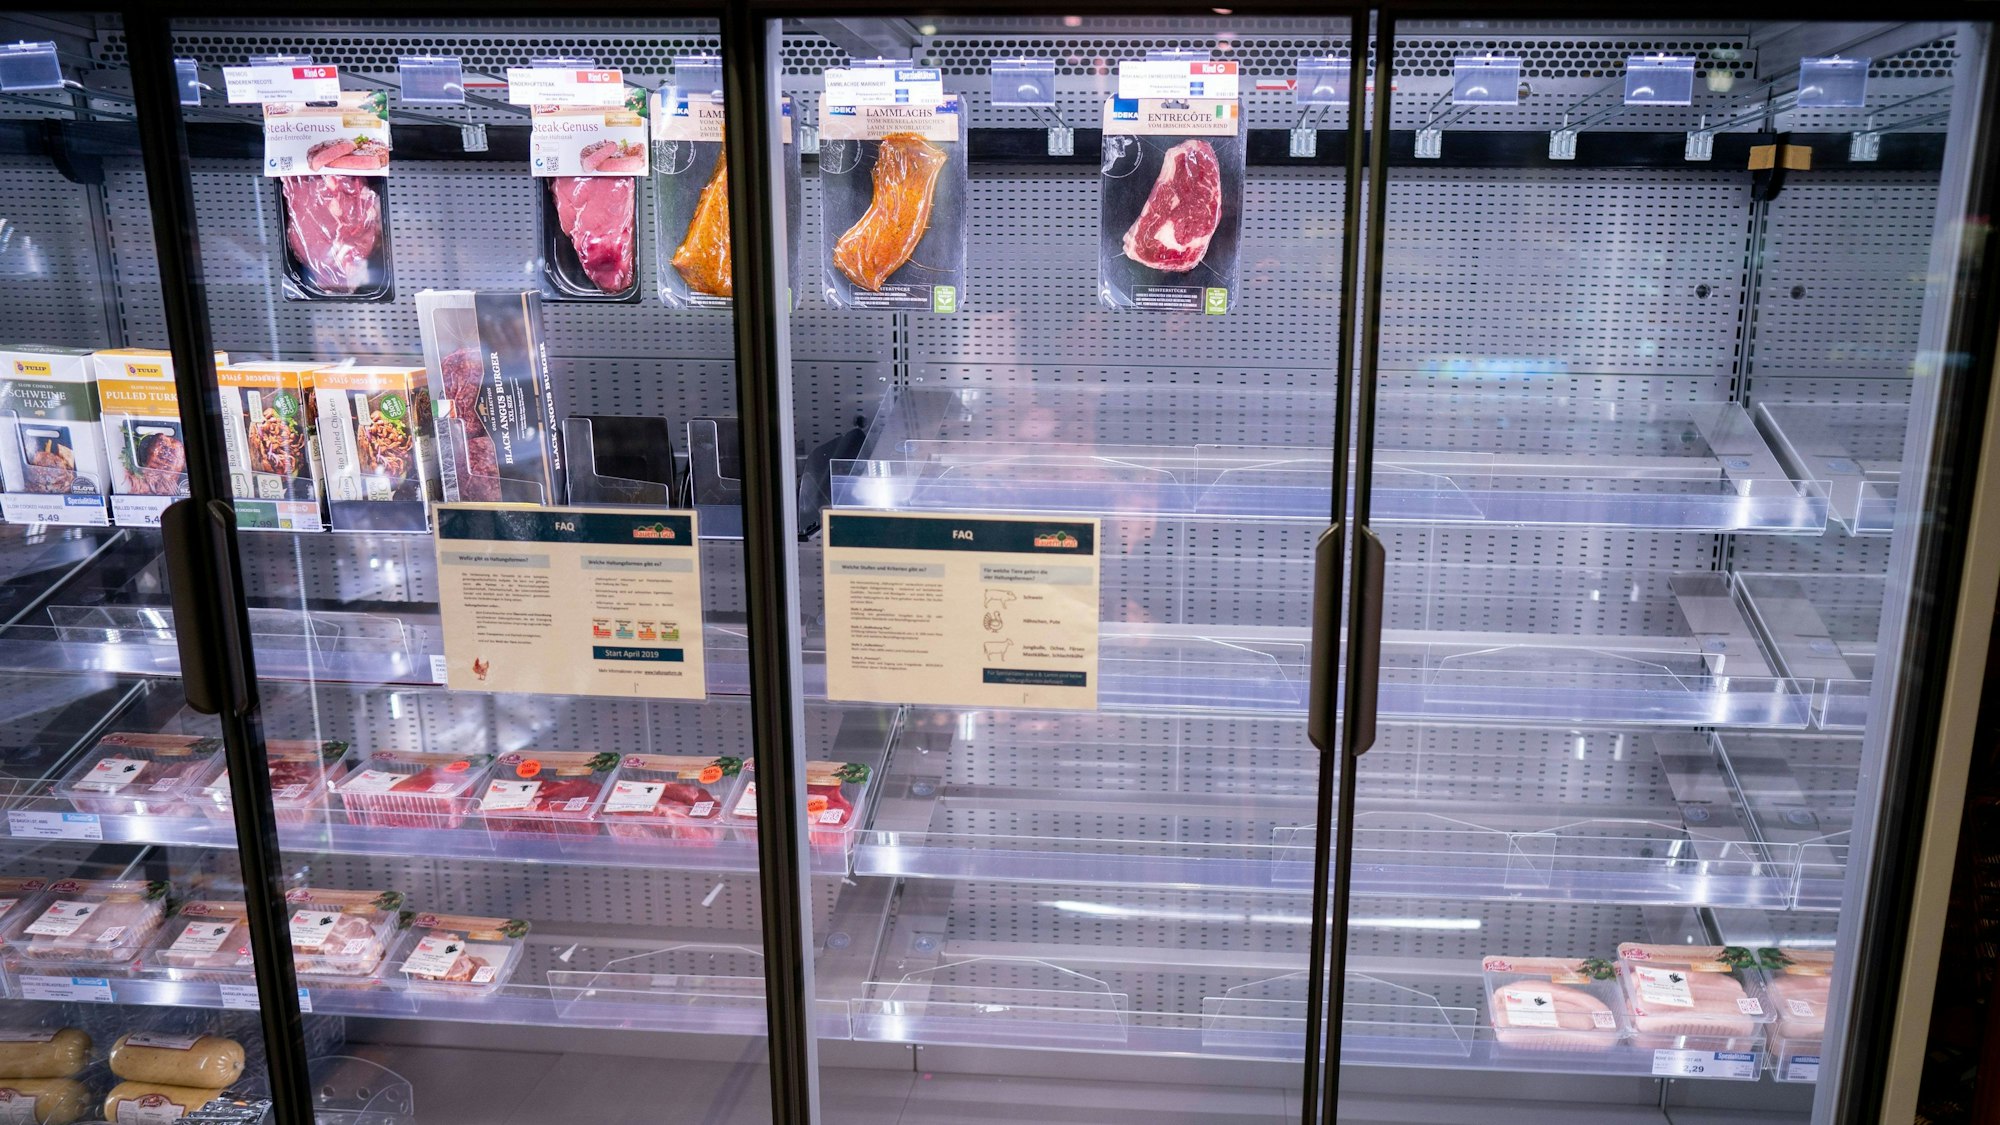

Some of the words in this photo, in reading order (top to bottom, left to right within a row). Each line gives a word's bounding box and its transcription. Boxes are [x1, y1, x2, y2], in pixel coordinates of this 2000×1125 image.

[303, 68, 317, 78] Rind
[866, 108, 932, 118] LAMMLACHS
[1148, 111, 1212, 122] ENTRECÔTE
[534, 121, 599, 133] Steak-Genuss
[539, 341, 551, 391] BURGER
[490, 351, 504, 394] BURGER
[8, 389, 67, 400] SCHWEINE
[106, 391, 147, 401] PULLED
[23, 399, 55, 409] HAXE
[487, 387, 495, 416] SELECTION
[221, 395, 230, 425] Chicken
[330, 398, 338, 428] Chicken
[497, 395, 509, 431] ANGUS
[546, 392, 557, 431] ANGUS
[226, 426, 234, 452] Pulled
[502, 431, 514, 465] BLACK
[551, 432, 561, 471] BLACK
[229, 454, 237, 467] Bio
[555, 521, 575, 533] FAQ
[633, 529, 658, 539] Bauern
[661, 531, 676, 540] Gut
[953, 530, 973, 541] FAQ
[1034, 537, 1059, 547] Bauern
[1062, 538, 1078, 548] Gut
[605, 649, 623, 658] Start
[624, 650, 641, 659] April
[641, 650, 660, 659] 2019
[1683, 1064, 1705, 1073] 2,29
